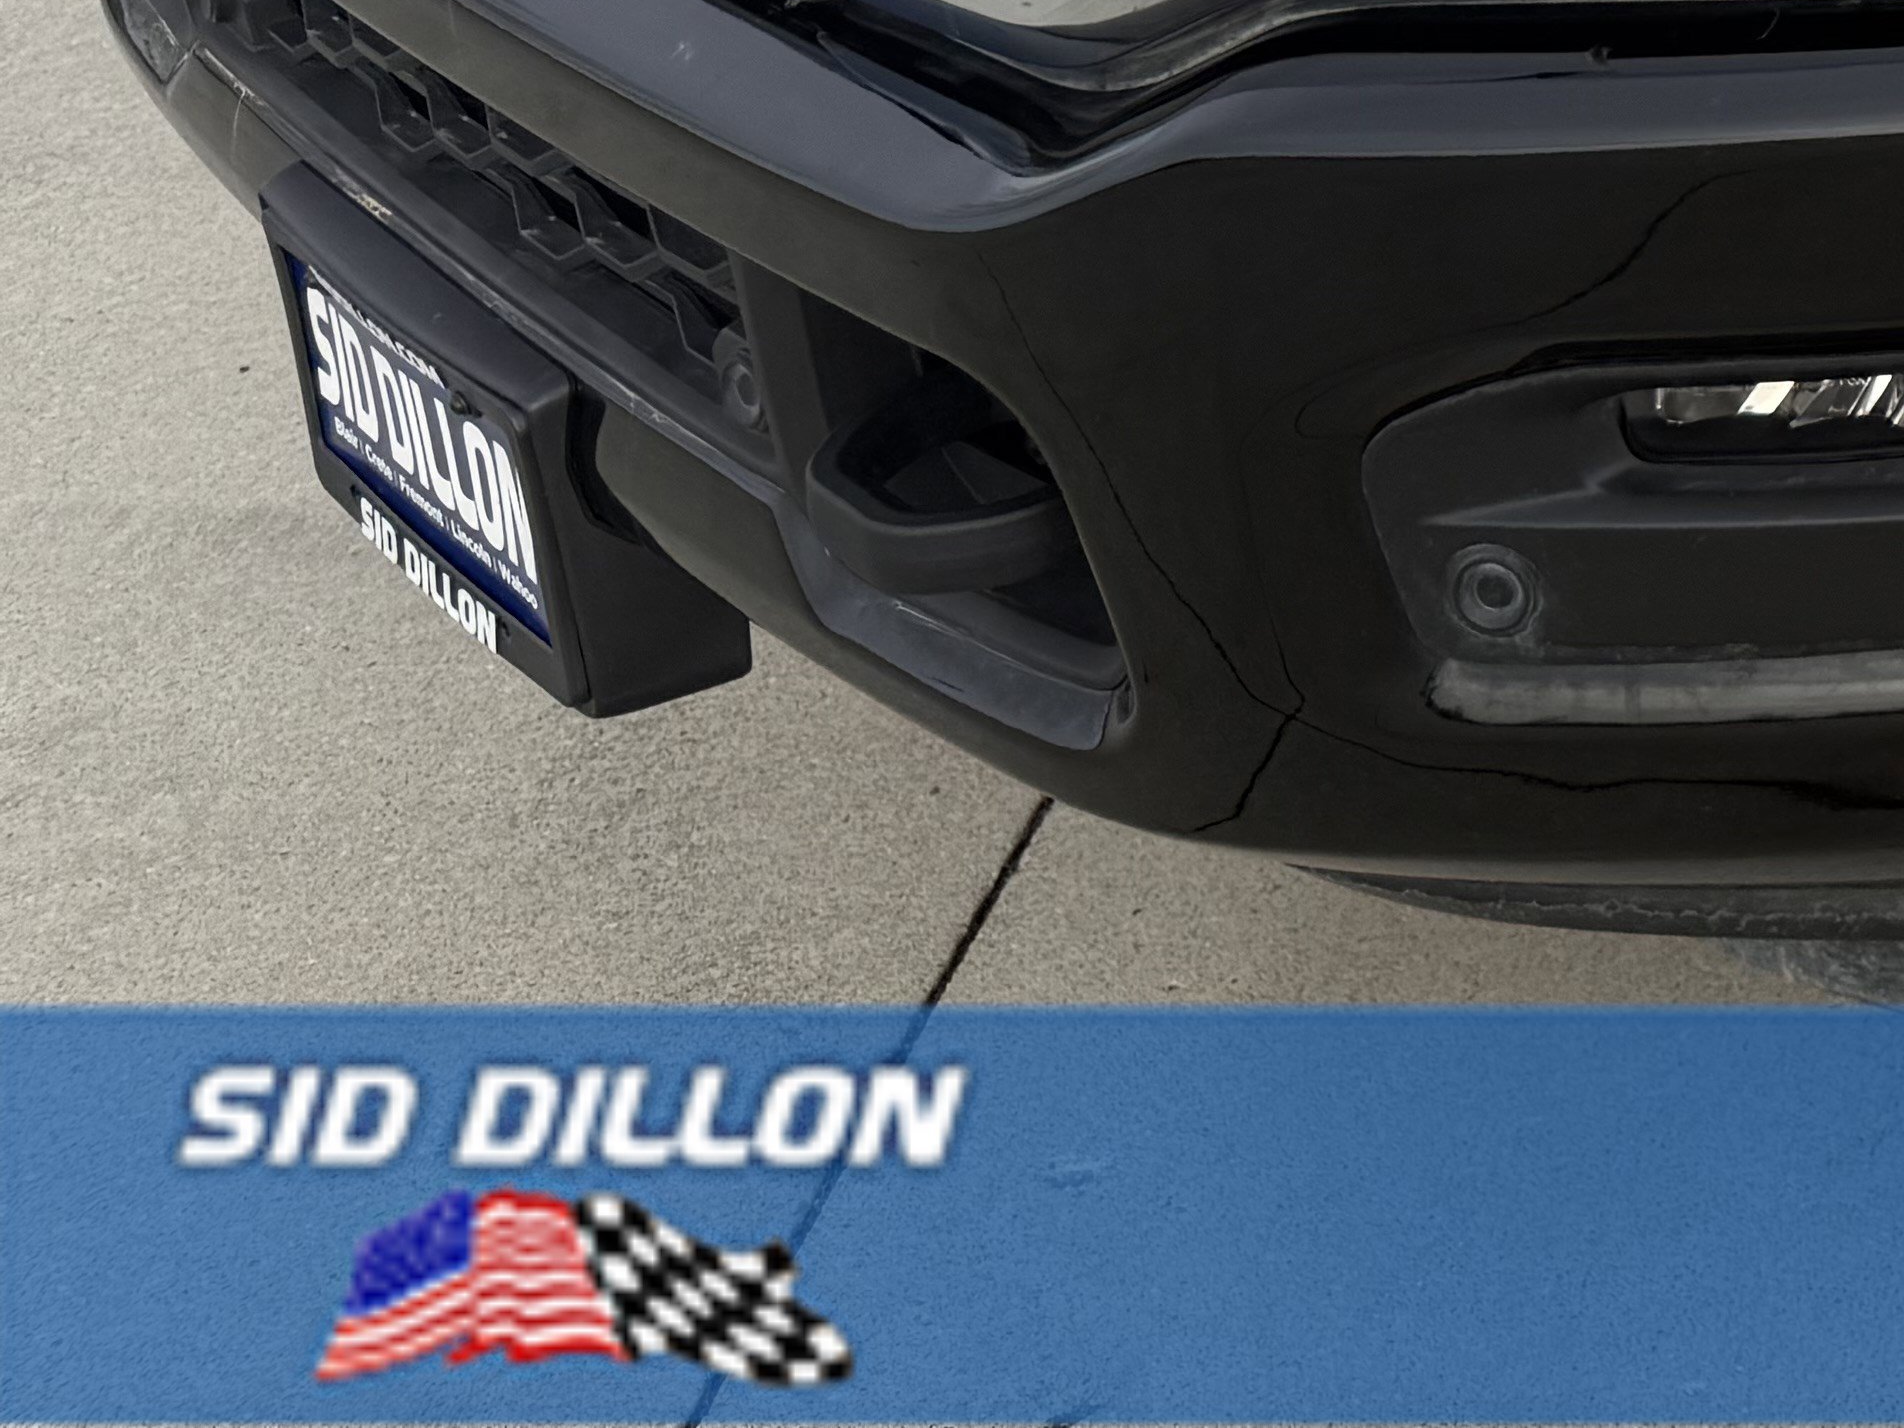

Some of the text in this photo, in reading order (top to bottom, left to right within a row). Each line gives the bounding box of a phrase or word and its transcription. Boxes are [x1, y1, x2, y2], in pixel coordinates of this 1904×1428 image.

[306, 285, 540, 585] SID DILLON
[357, 494, 499, 656] SID DILLON
[397, 471, 445, 528] Fremont
[449, 514, 493, 570] Lincoln
[496, 556, 540, 611] Wahoo
